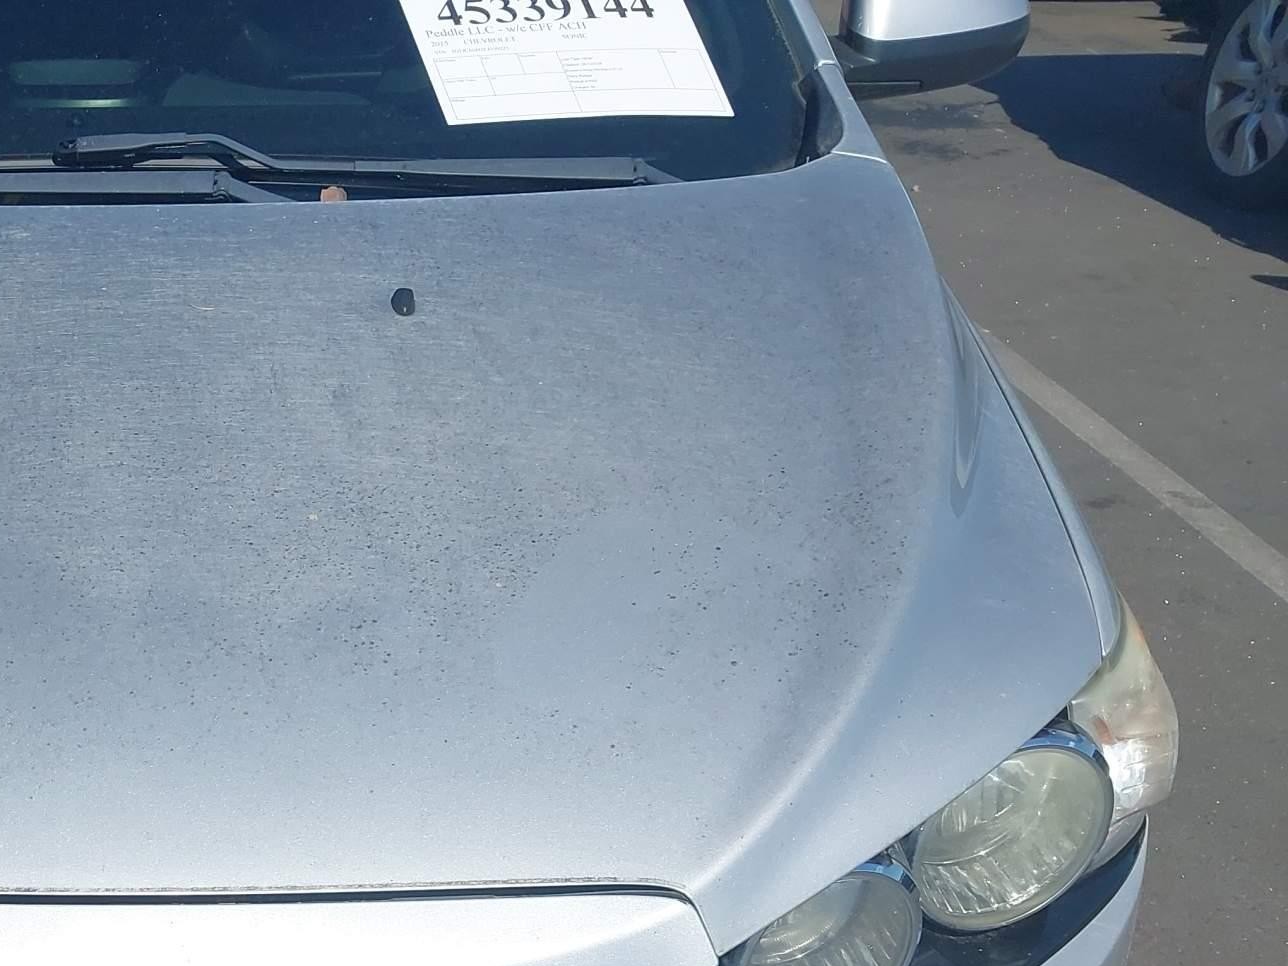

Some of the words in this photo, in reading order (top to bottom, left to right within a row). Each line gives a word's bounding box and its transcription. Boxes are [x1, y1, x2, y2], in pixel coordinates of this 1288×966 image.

[437, 0, 655, 25] 45339144
[425, 27, 465, 39] Peddle
[468, 25, 495, 36] LLC
